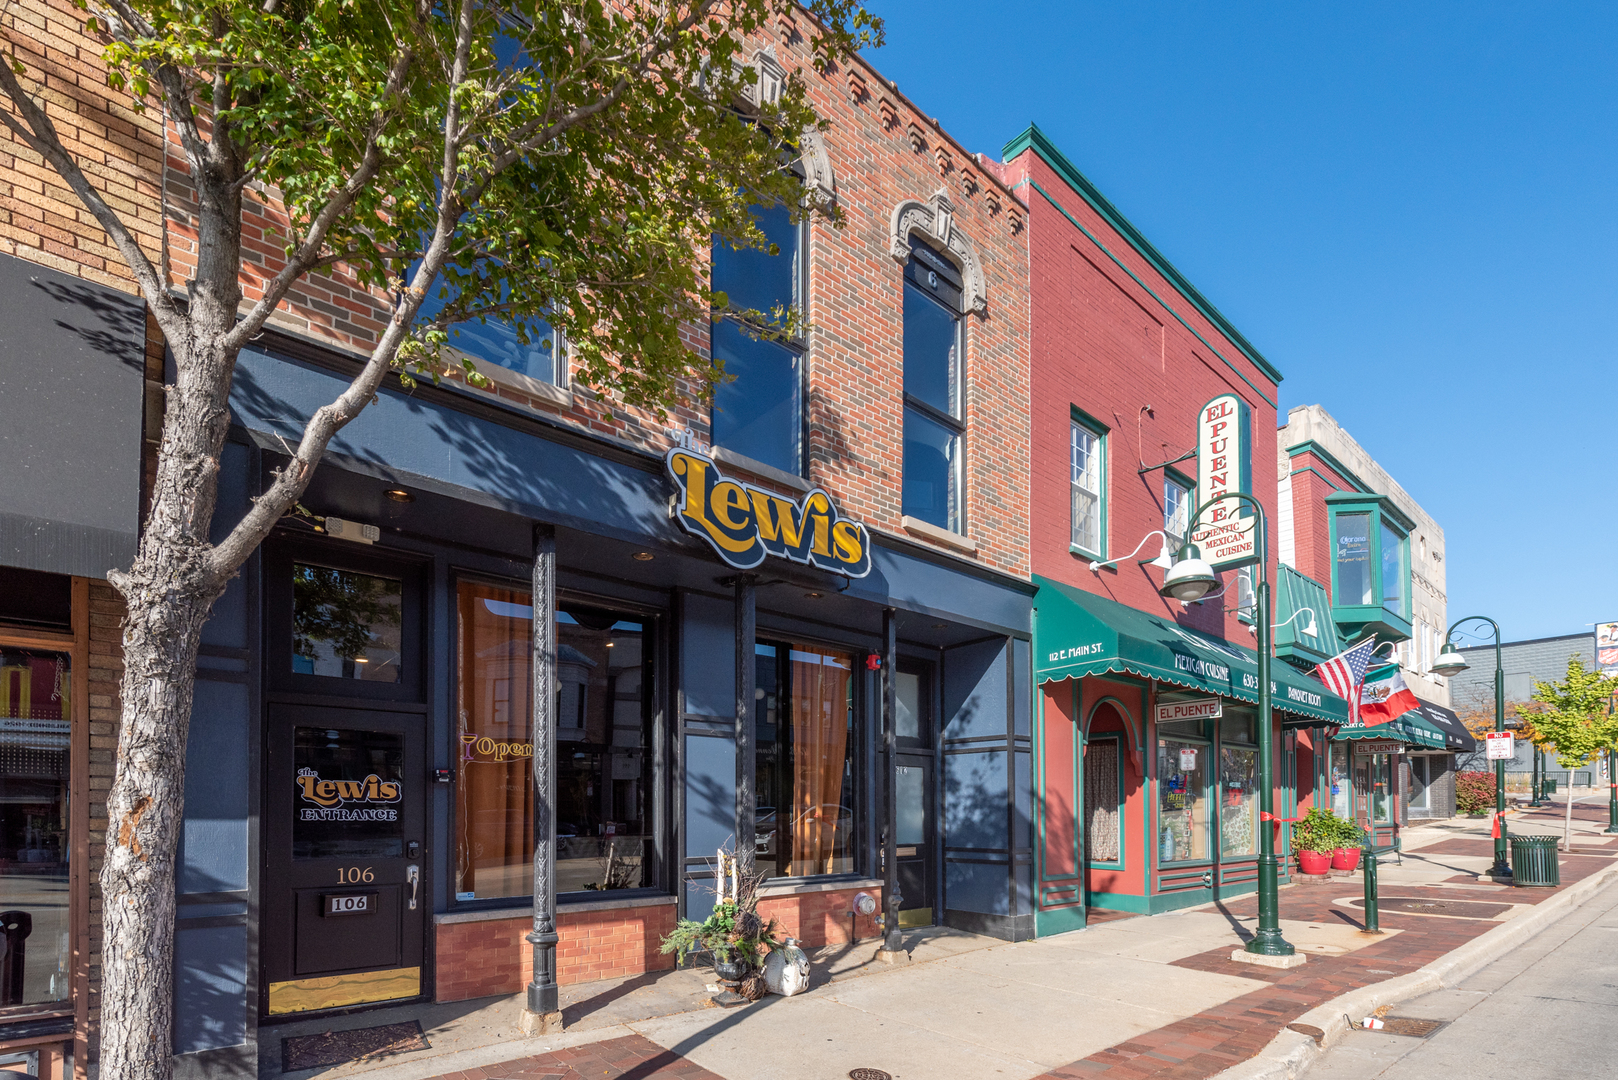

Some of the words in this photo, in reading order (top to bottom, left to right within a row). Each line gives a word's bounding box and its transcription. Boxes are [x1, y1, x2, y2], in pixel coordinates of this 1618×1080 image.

[928, 270, 938, 288] 6
[1205, 401, 1233, 424] EL
[671, 428, 710, 454] The
[1209, 421, 1229, 524] PUENTE
[670, 451, 866, 572] Lewis
[1191, 522, 1240, 543] AUTHENTIC
[1205, 532, 1245, 550] MEXICAN
[1340, 536, 1366, 544] Corona
[1215, 541, 1253, 558] CUISINE
[1049, 652, 1059, 661] 112
[1068, 645, 1090, 658] MAIN
[1091, 642, 1104, 653] ST.
[1174, 653, 1205, 676] MEXICAN
[1205, 662, 1230, 682] CUISINE
[1309, 692, 1322, 708] ROOM
[1160, 708, 1173, 719] EL
[1174, 703, 1216, 718] PUENTE
[476, 737, 535, 761] Open
[1358, 745, 1367, 753] EL
[1369, 743, 1400, 752] PUENTE
[298, 767, 318, 776] The
[297, 775, 402, 808] Lewis
[300, 808, 398, 821] ENTRANCE
[336, 866, 375, 884] 106
[334, 898, 366, 911] 106
